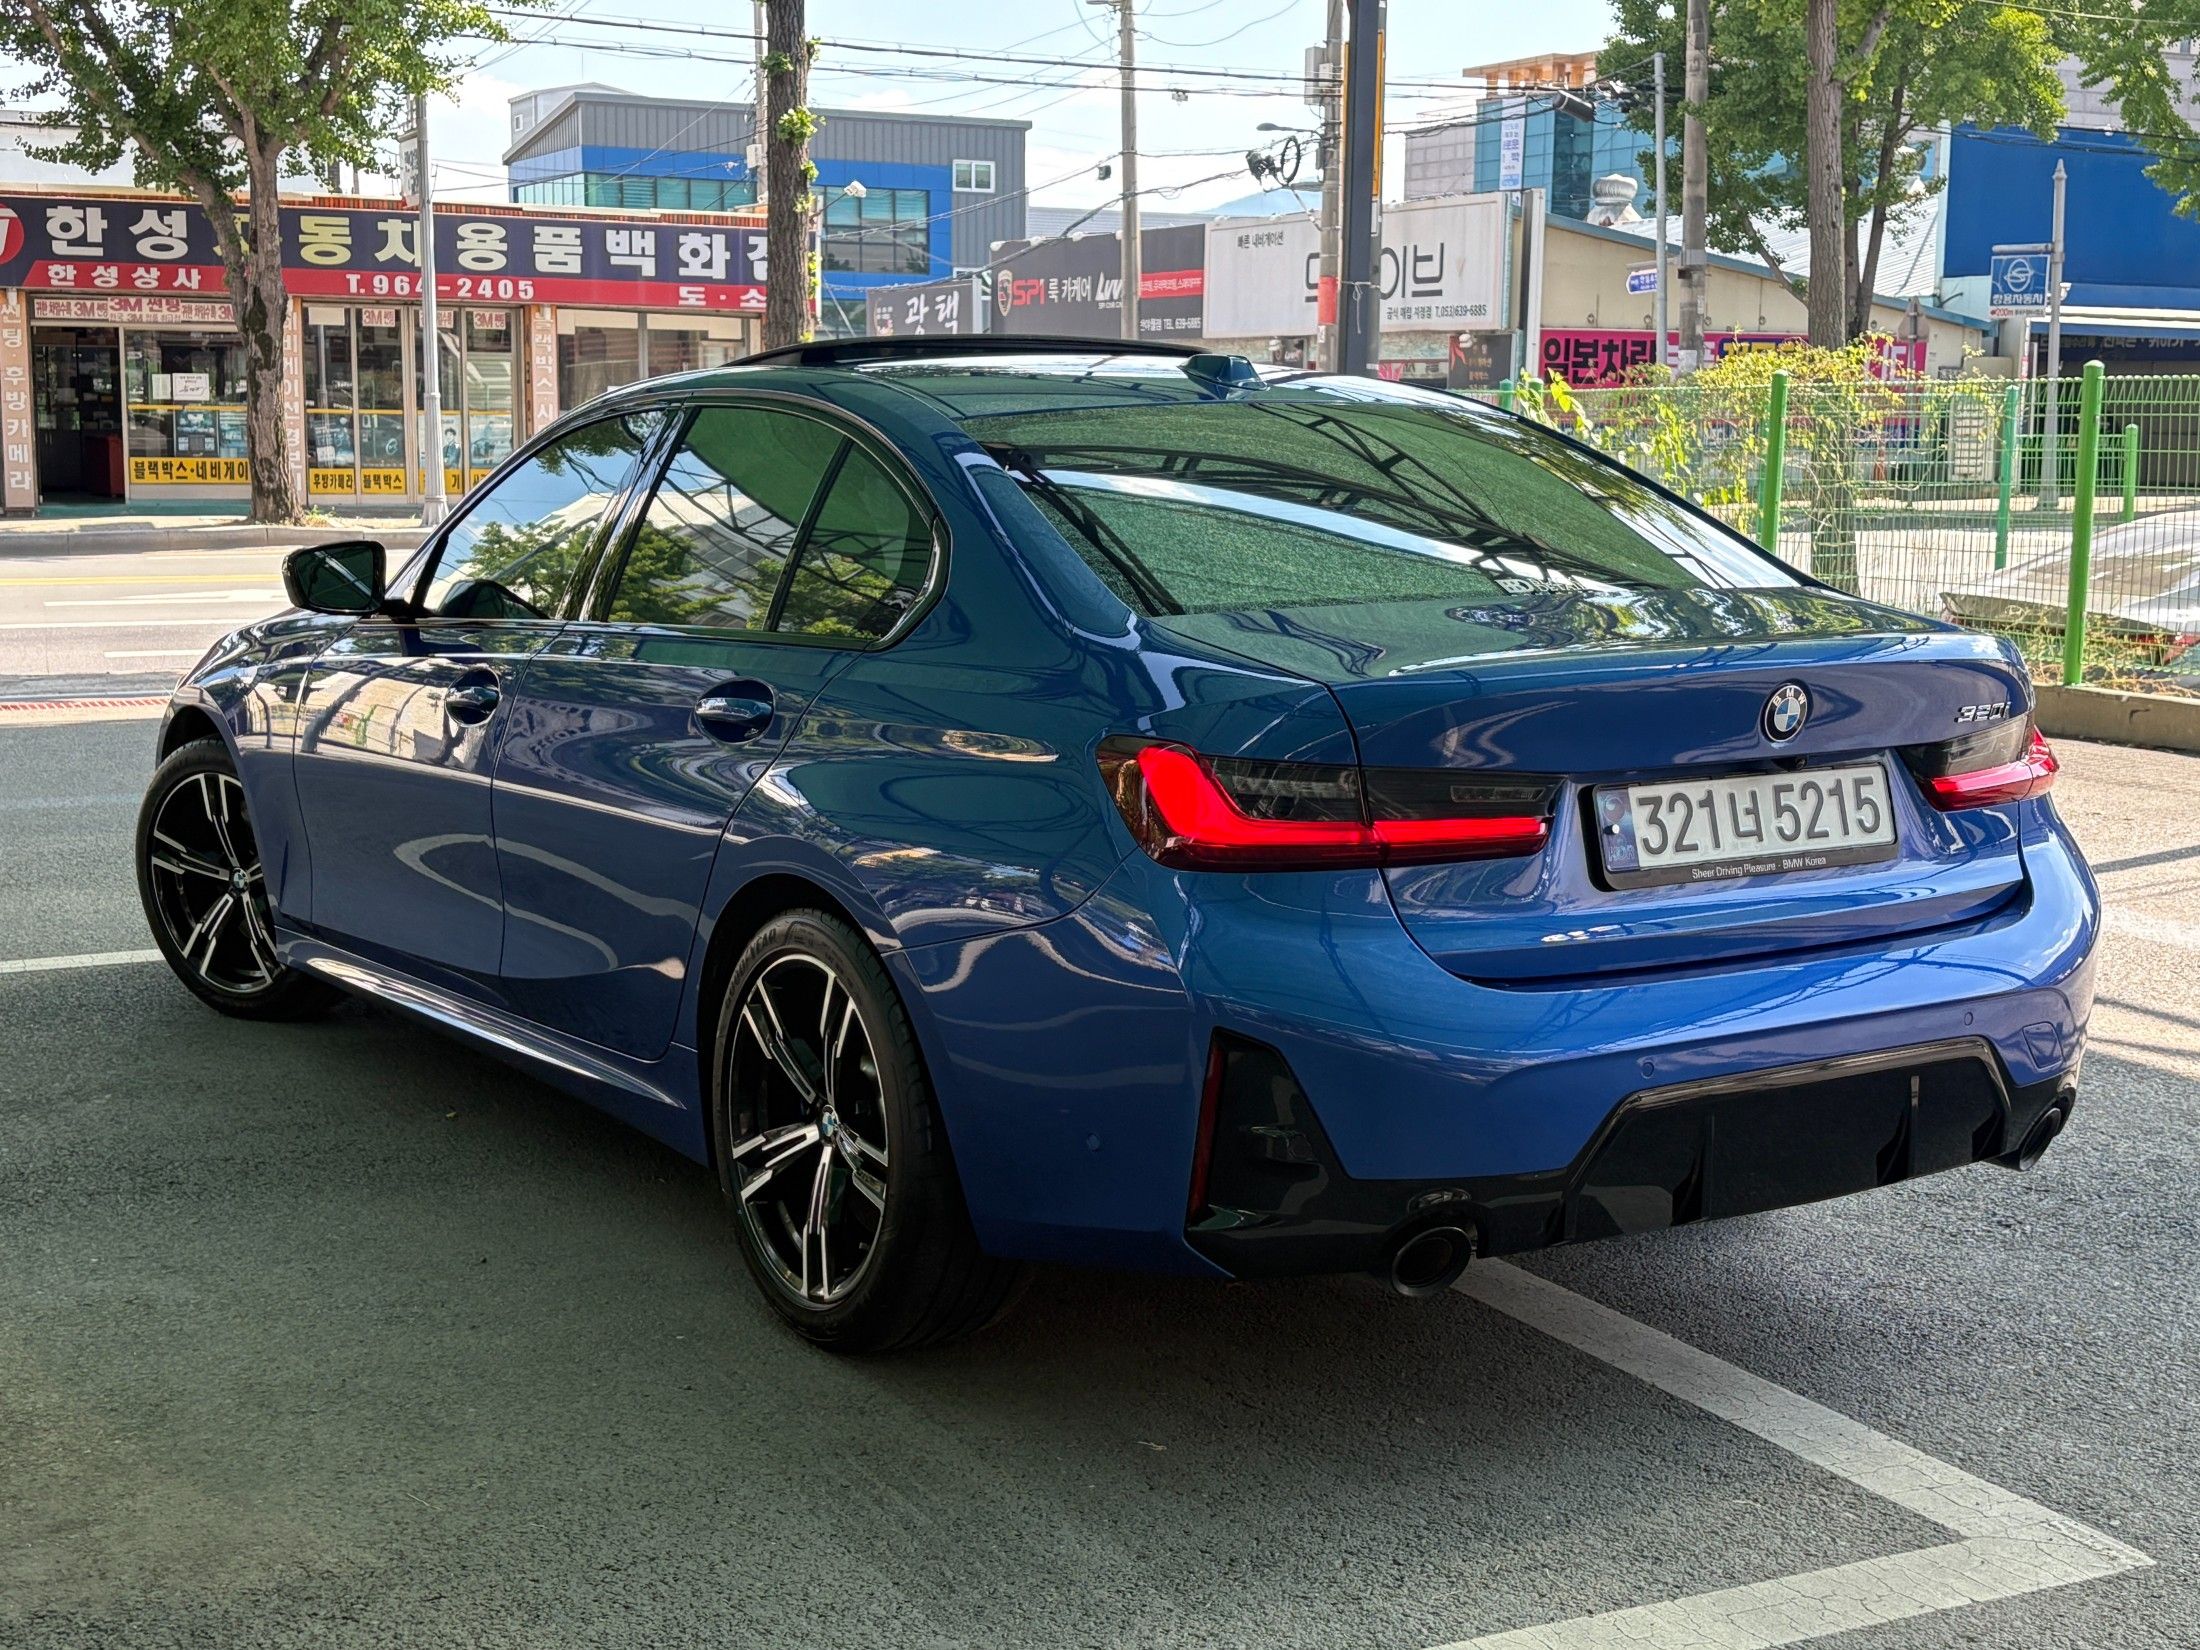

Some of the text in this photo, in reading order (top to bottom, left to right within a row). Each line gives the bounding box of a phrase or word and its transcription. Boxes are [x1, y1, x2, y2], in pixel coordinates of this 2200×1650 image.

[46, 205, 189, 260] 한성
[48, 264, 201, 290] 한성상사
[109, 297, 181, 313] 3M 썬팅
[1992, 293, 2043, 305] 쌍용자동차
[74, 302, 95, 317] 3M
[363, 309, 382, 325] 3M
[474, 312, 493, 328] 3M
[1773, 687, 1806, 706] BMW
[1957, 701, 2011, 723] 320i
[1638, 776, 1881, 855] 321너5215
[1691, 868, 1715, 879] Sheer
[1716, 865, 1743, 878] Driving
[1743, 861, 1776, 873] Pleasure
[1783, 858, 1803, 869] BMW
[1805, 856, 1826, 867] Korea
